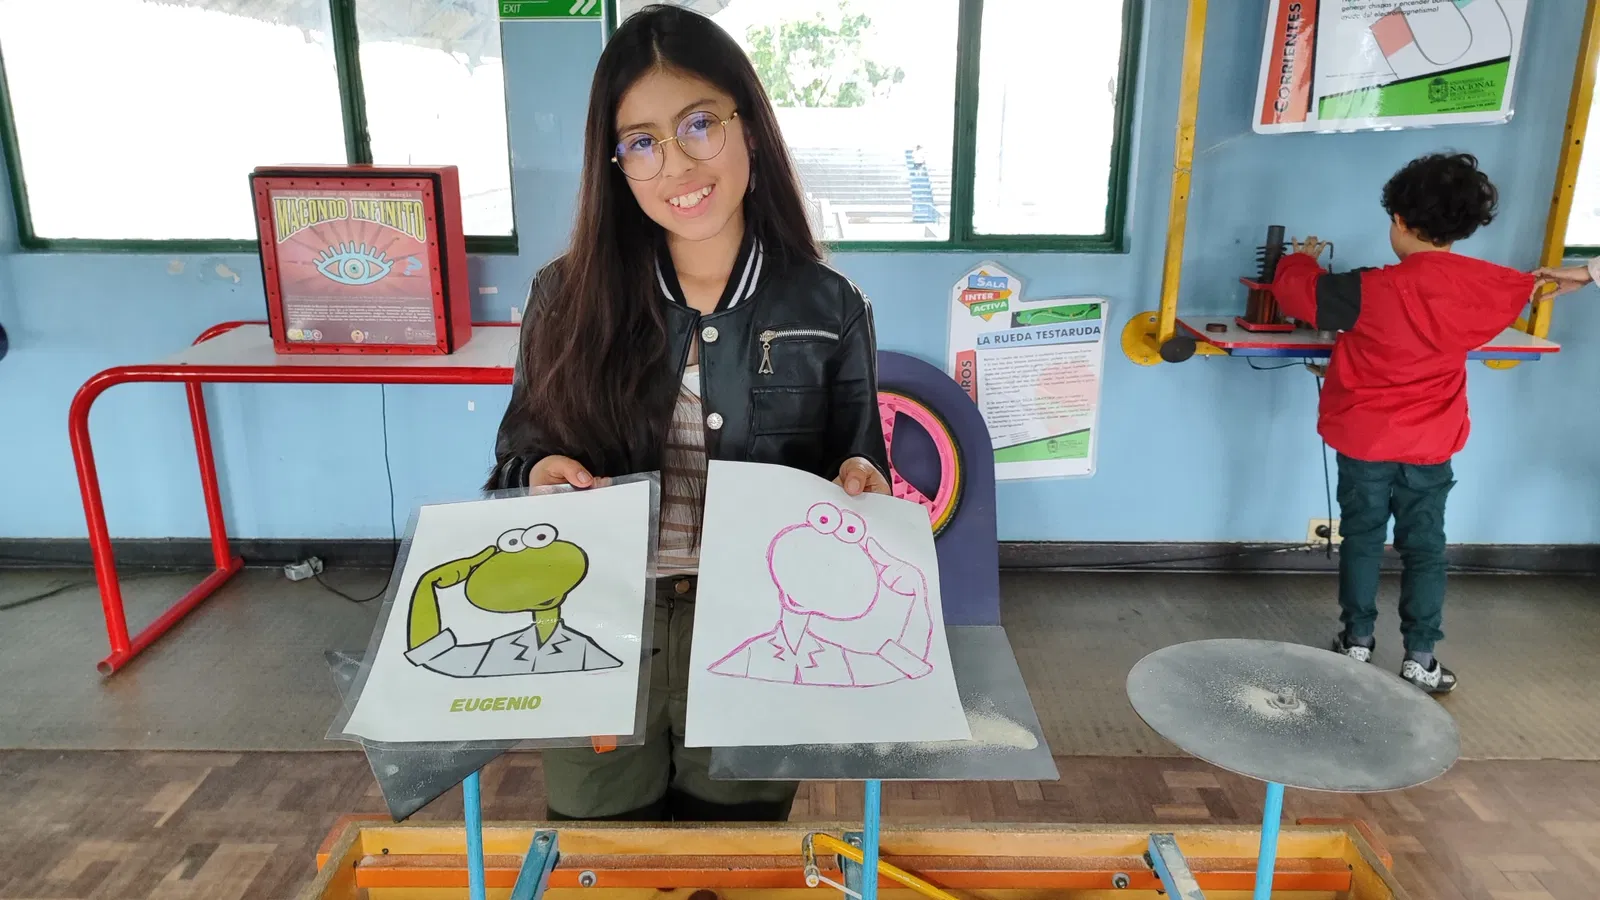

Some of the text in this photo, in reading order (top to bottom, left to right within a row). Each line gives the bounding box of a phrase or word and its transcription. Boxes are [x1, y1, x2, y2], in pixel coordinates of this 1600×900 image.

[503, 4, 521, 13] EXIT
[1341, 4, 1366, 12] generar
[1274, 3, 1301, 113] CORRIENTES
[1450, 80, 1496, 91] NACIONAL
[274, 198, 426, 243] MACONDO INFINITO
[977, 276, 1006, 289] SALA
[965, 292, 994, 301] INTER
[973, 300, 1008, 313] ACTIVA
[977, 326, 1101, 345] LA RUEDA TESTARUDA
[961, 360, 972, 392] IROS
[449, 695, 542, 713] EUGENIO
